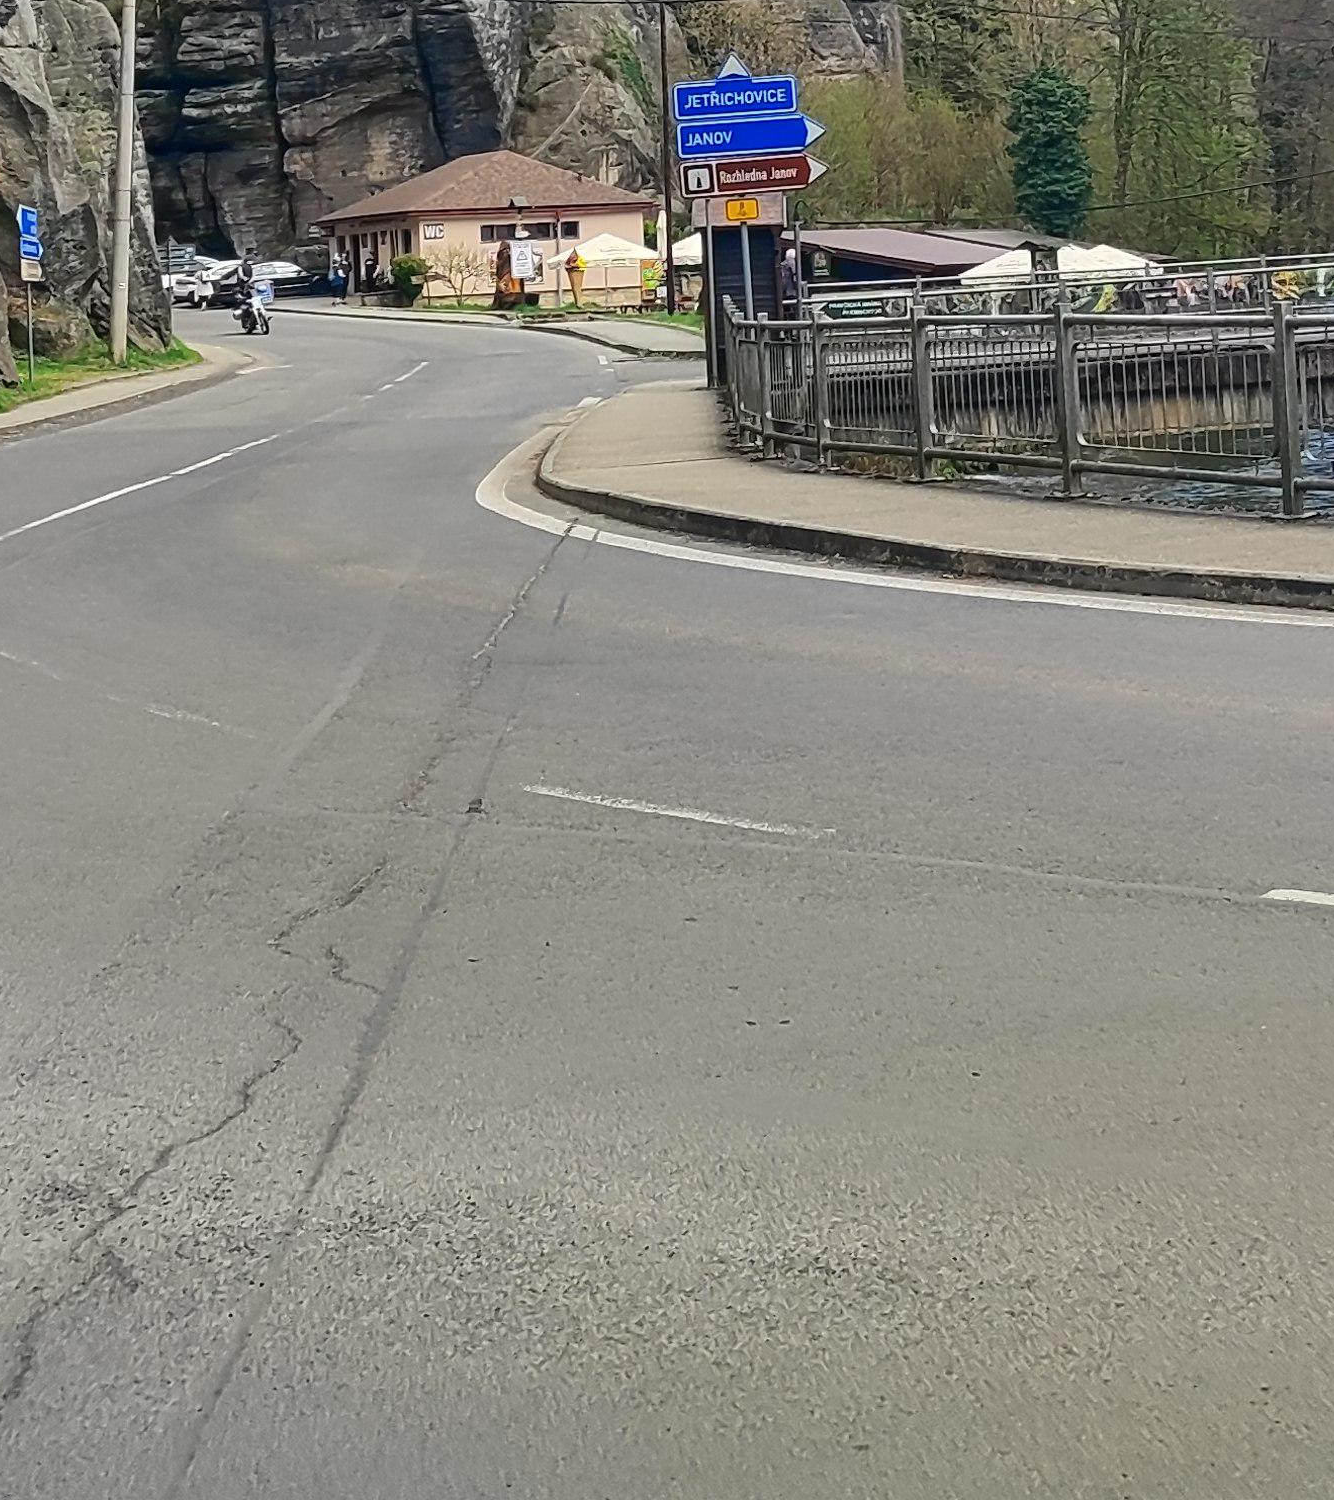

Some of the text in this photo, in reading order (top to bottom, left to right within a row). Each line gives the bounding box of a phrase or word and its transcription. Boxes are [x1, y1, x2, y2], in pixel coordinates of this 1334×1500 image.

[684, 88, 787, 109] JETŘICHOVICE
[685, 131, 733, 147] JANOV
[719, 167, 799, 184] Rozhledna Janov
[423, 224, 445, 239] WC
